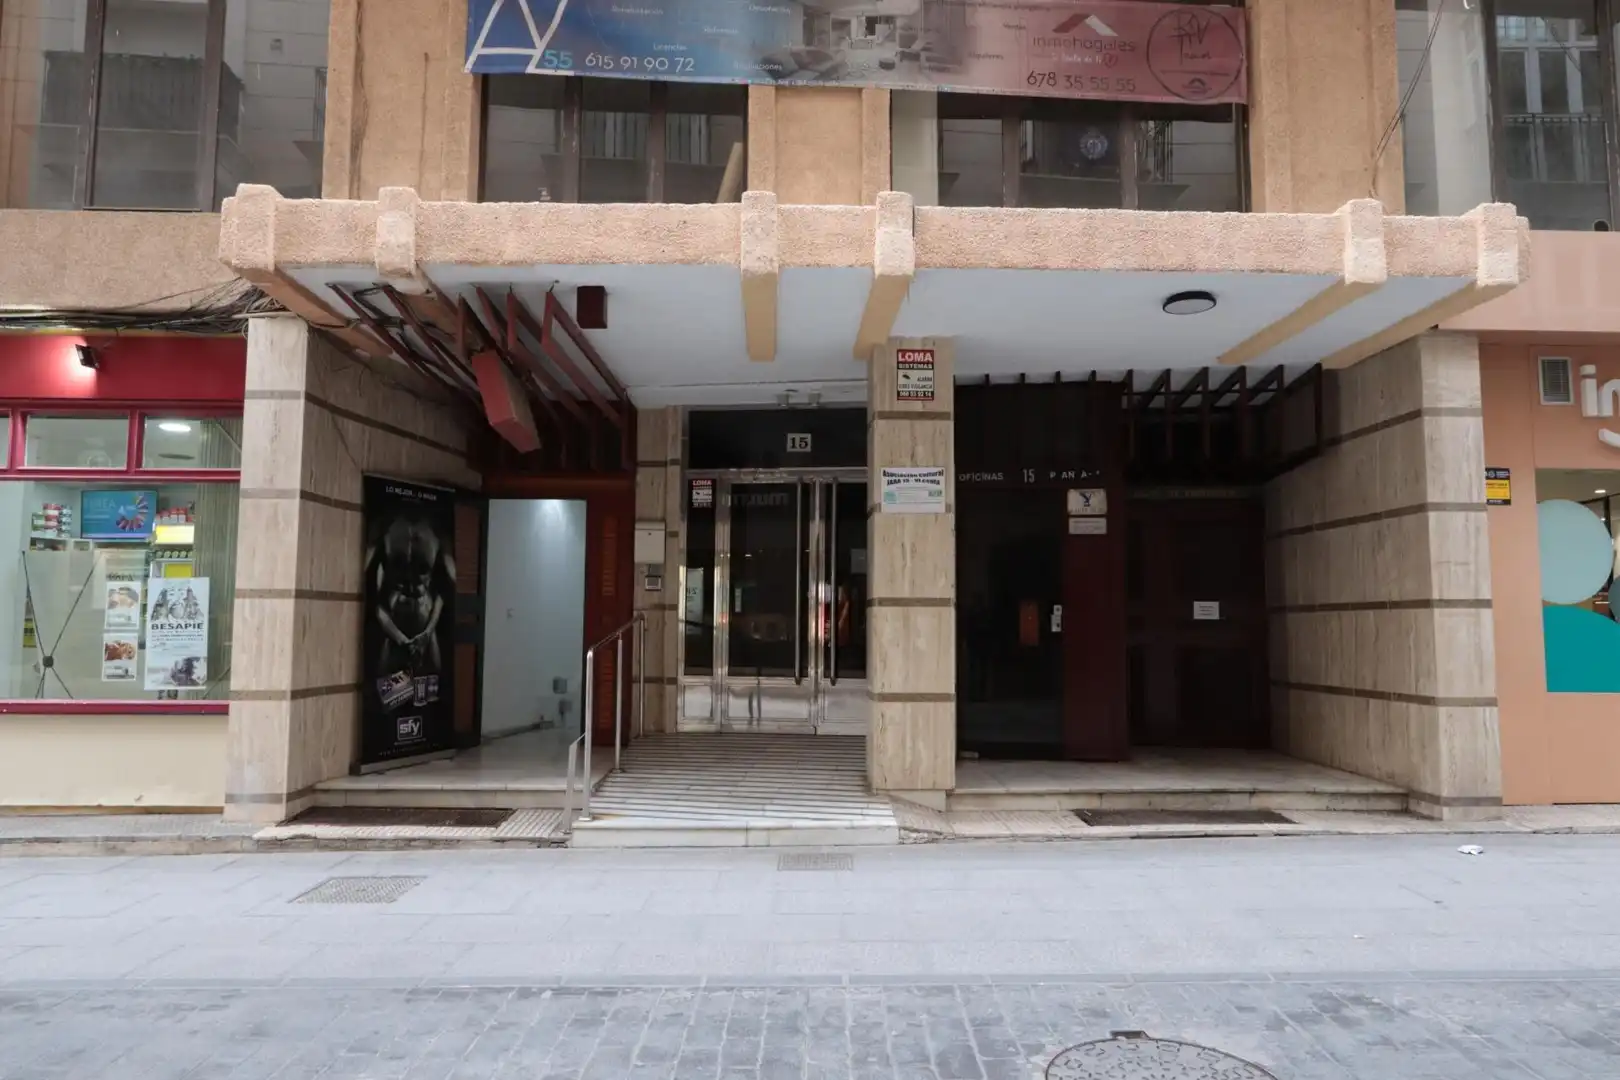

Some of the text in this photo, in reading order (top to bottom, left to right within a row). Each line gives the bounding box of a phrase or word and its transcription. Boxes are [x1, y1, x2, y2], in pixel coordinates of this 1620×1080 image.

[543, 49, 573, 68] 55
[585, 52, 695, 72] 615 91 90 72
[1027, 70, 1136, 92] 678 35 55 55
[898, 352, 933, 362] LOMA
[790, 437, 808, 449] 15
[958, 472, 1004, 481] OFICINAS
[1023, 469, 1035, 483] 15
[399, 719, 420, 735] sfy
